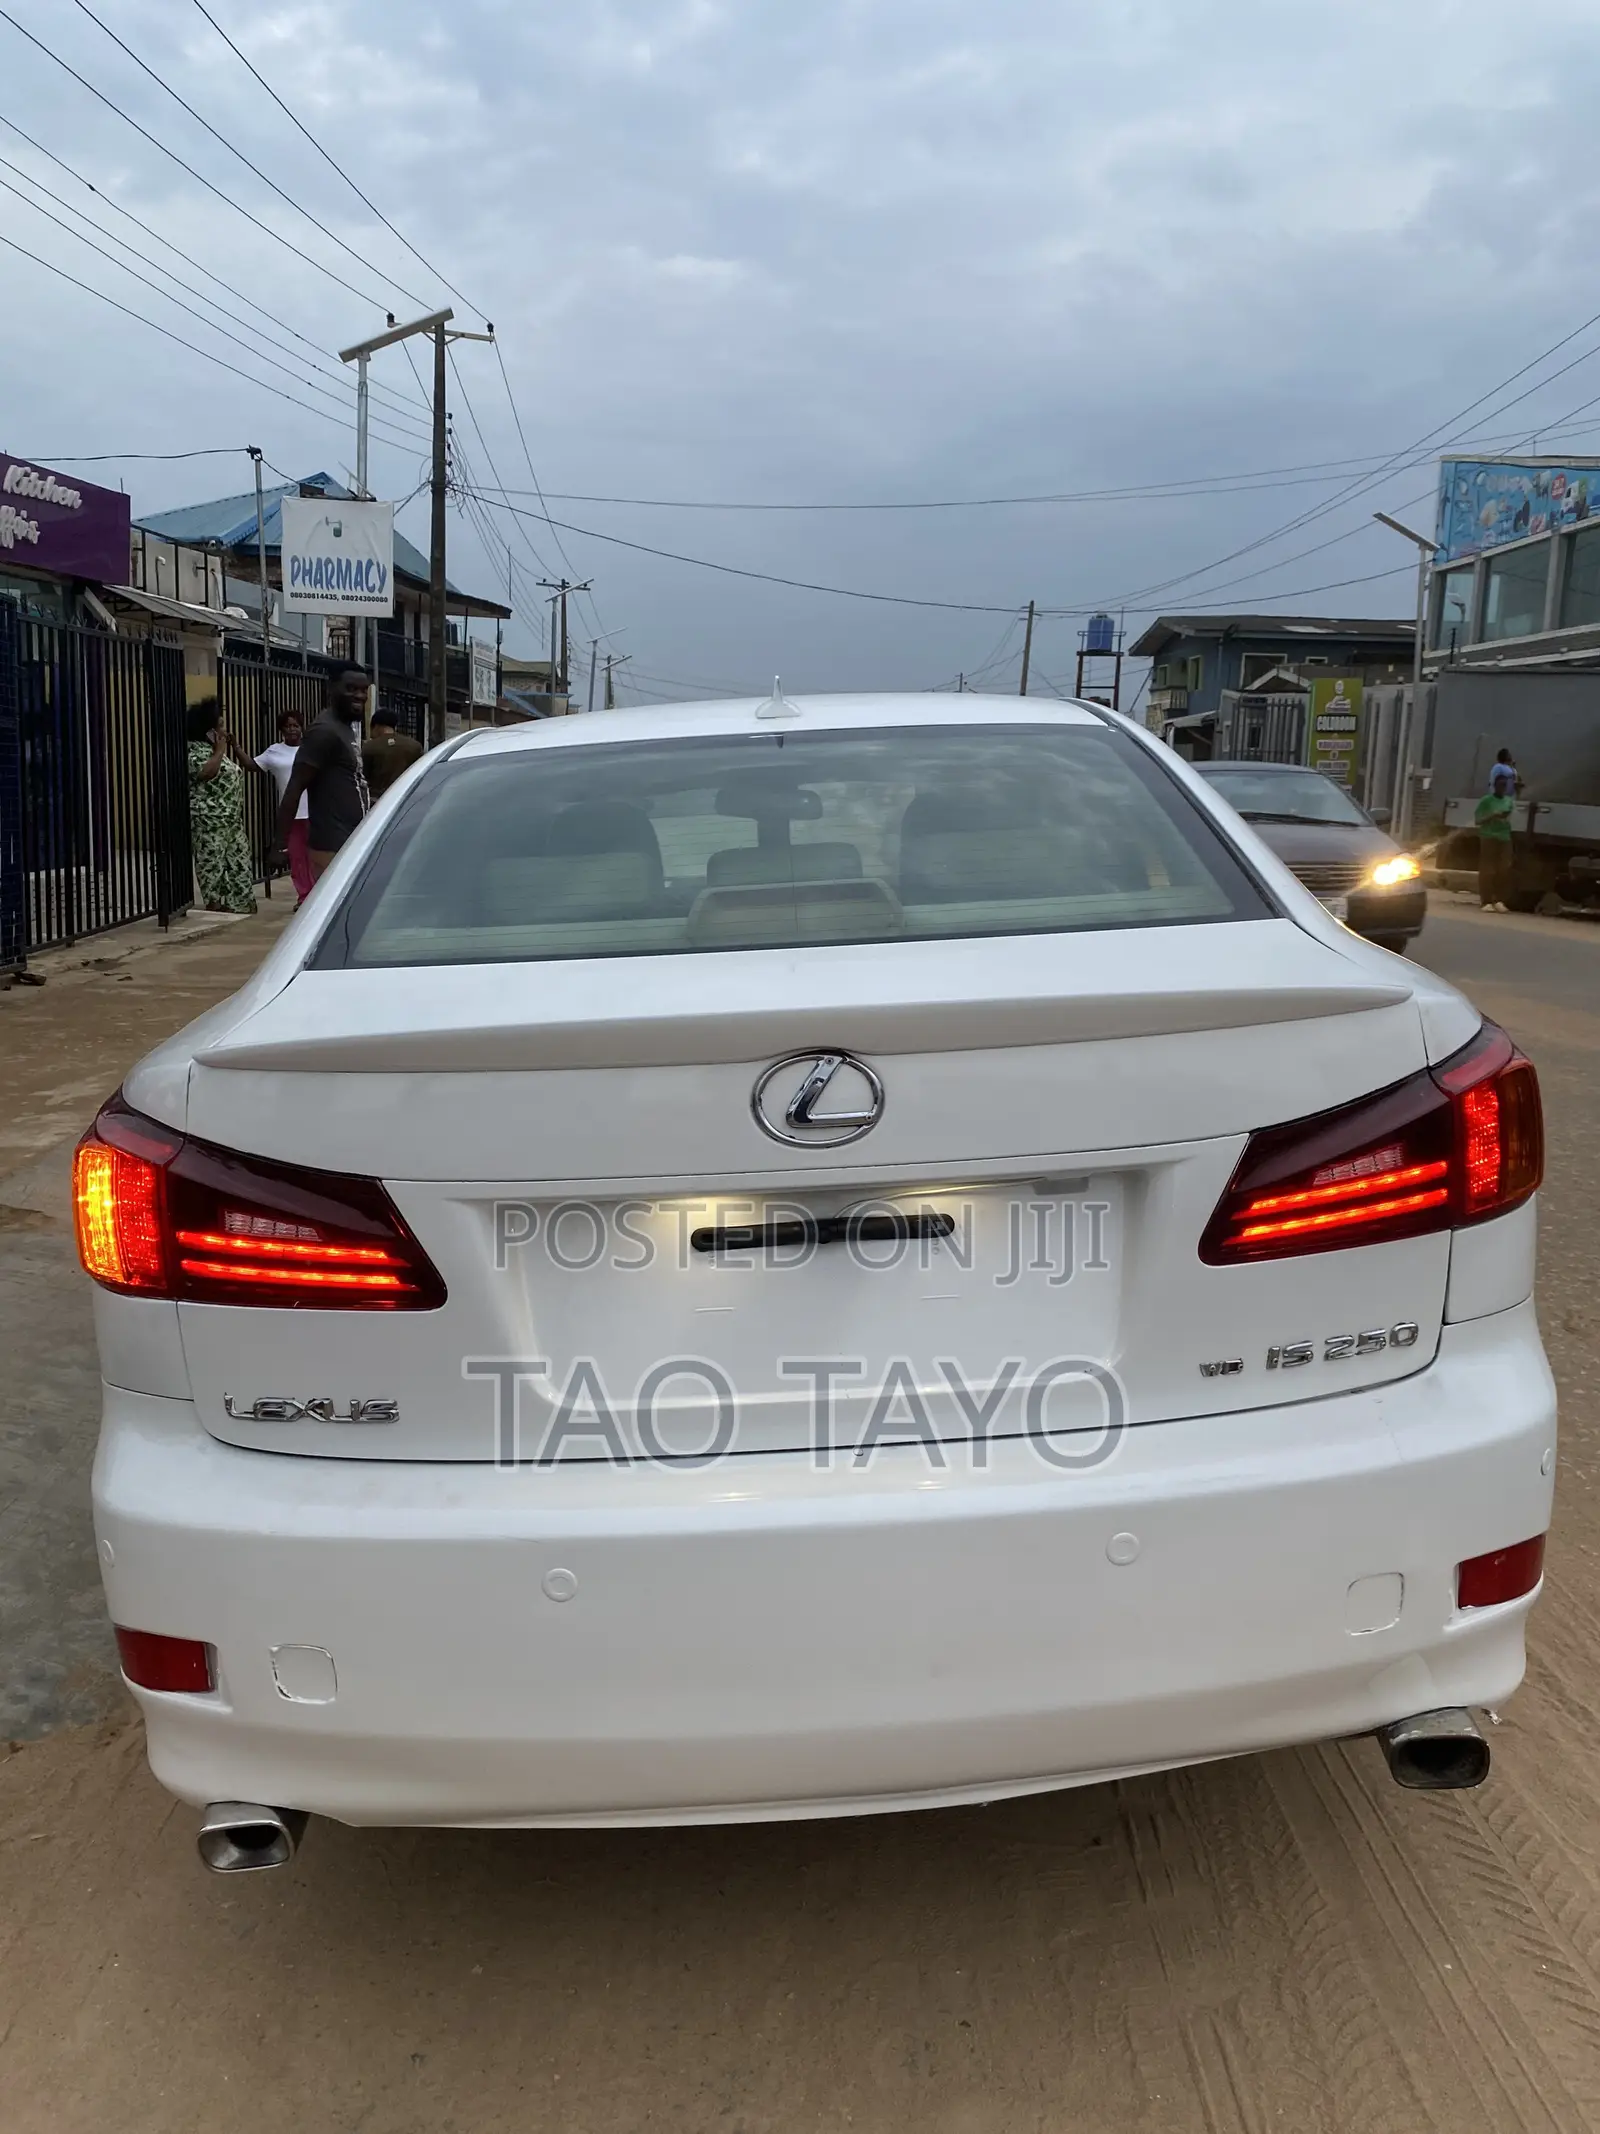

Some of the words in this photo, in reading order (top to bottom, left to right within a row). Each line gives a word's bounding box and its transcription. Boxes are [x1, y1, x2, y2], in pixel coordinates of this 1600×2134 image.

[3, 464, 82, 509] Kitchen
[290, 555, 387, 594] PHARMACY
[1265, 1340, 1314, 1370] IS
[1324, 1322, 1418, 1361] 250
[224, 1393, 399, 1424] LEXUS
